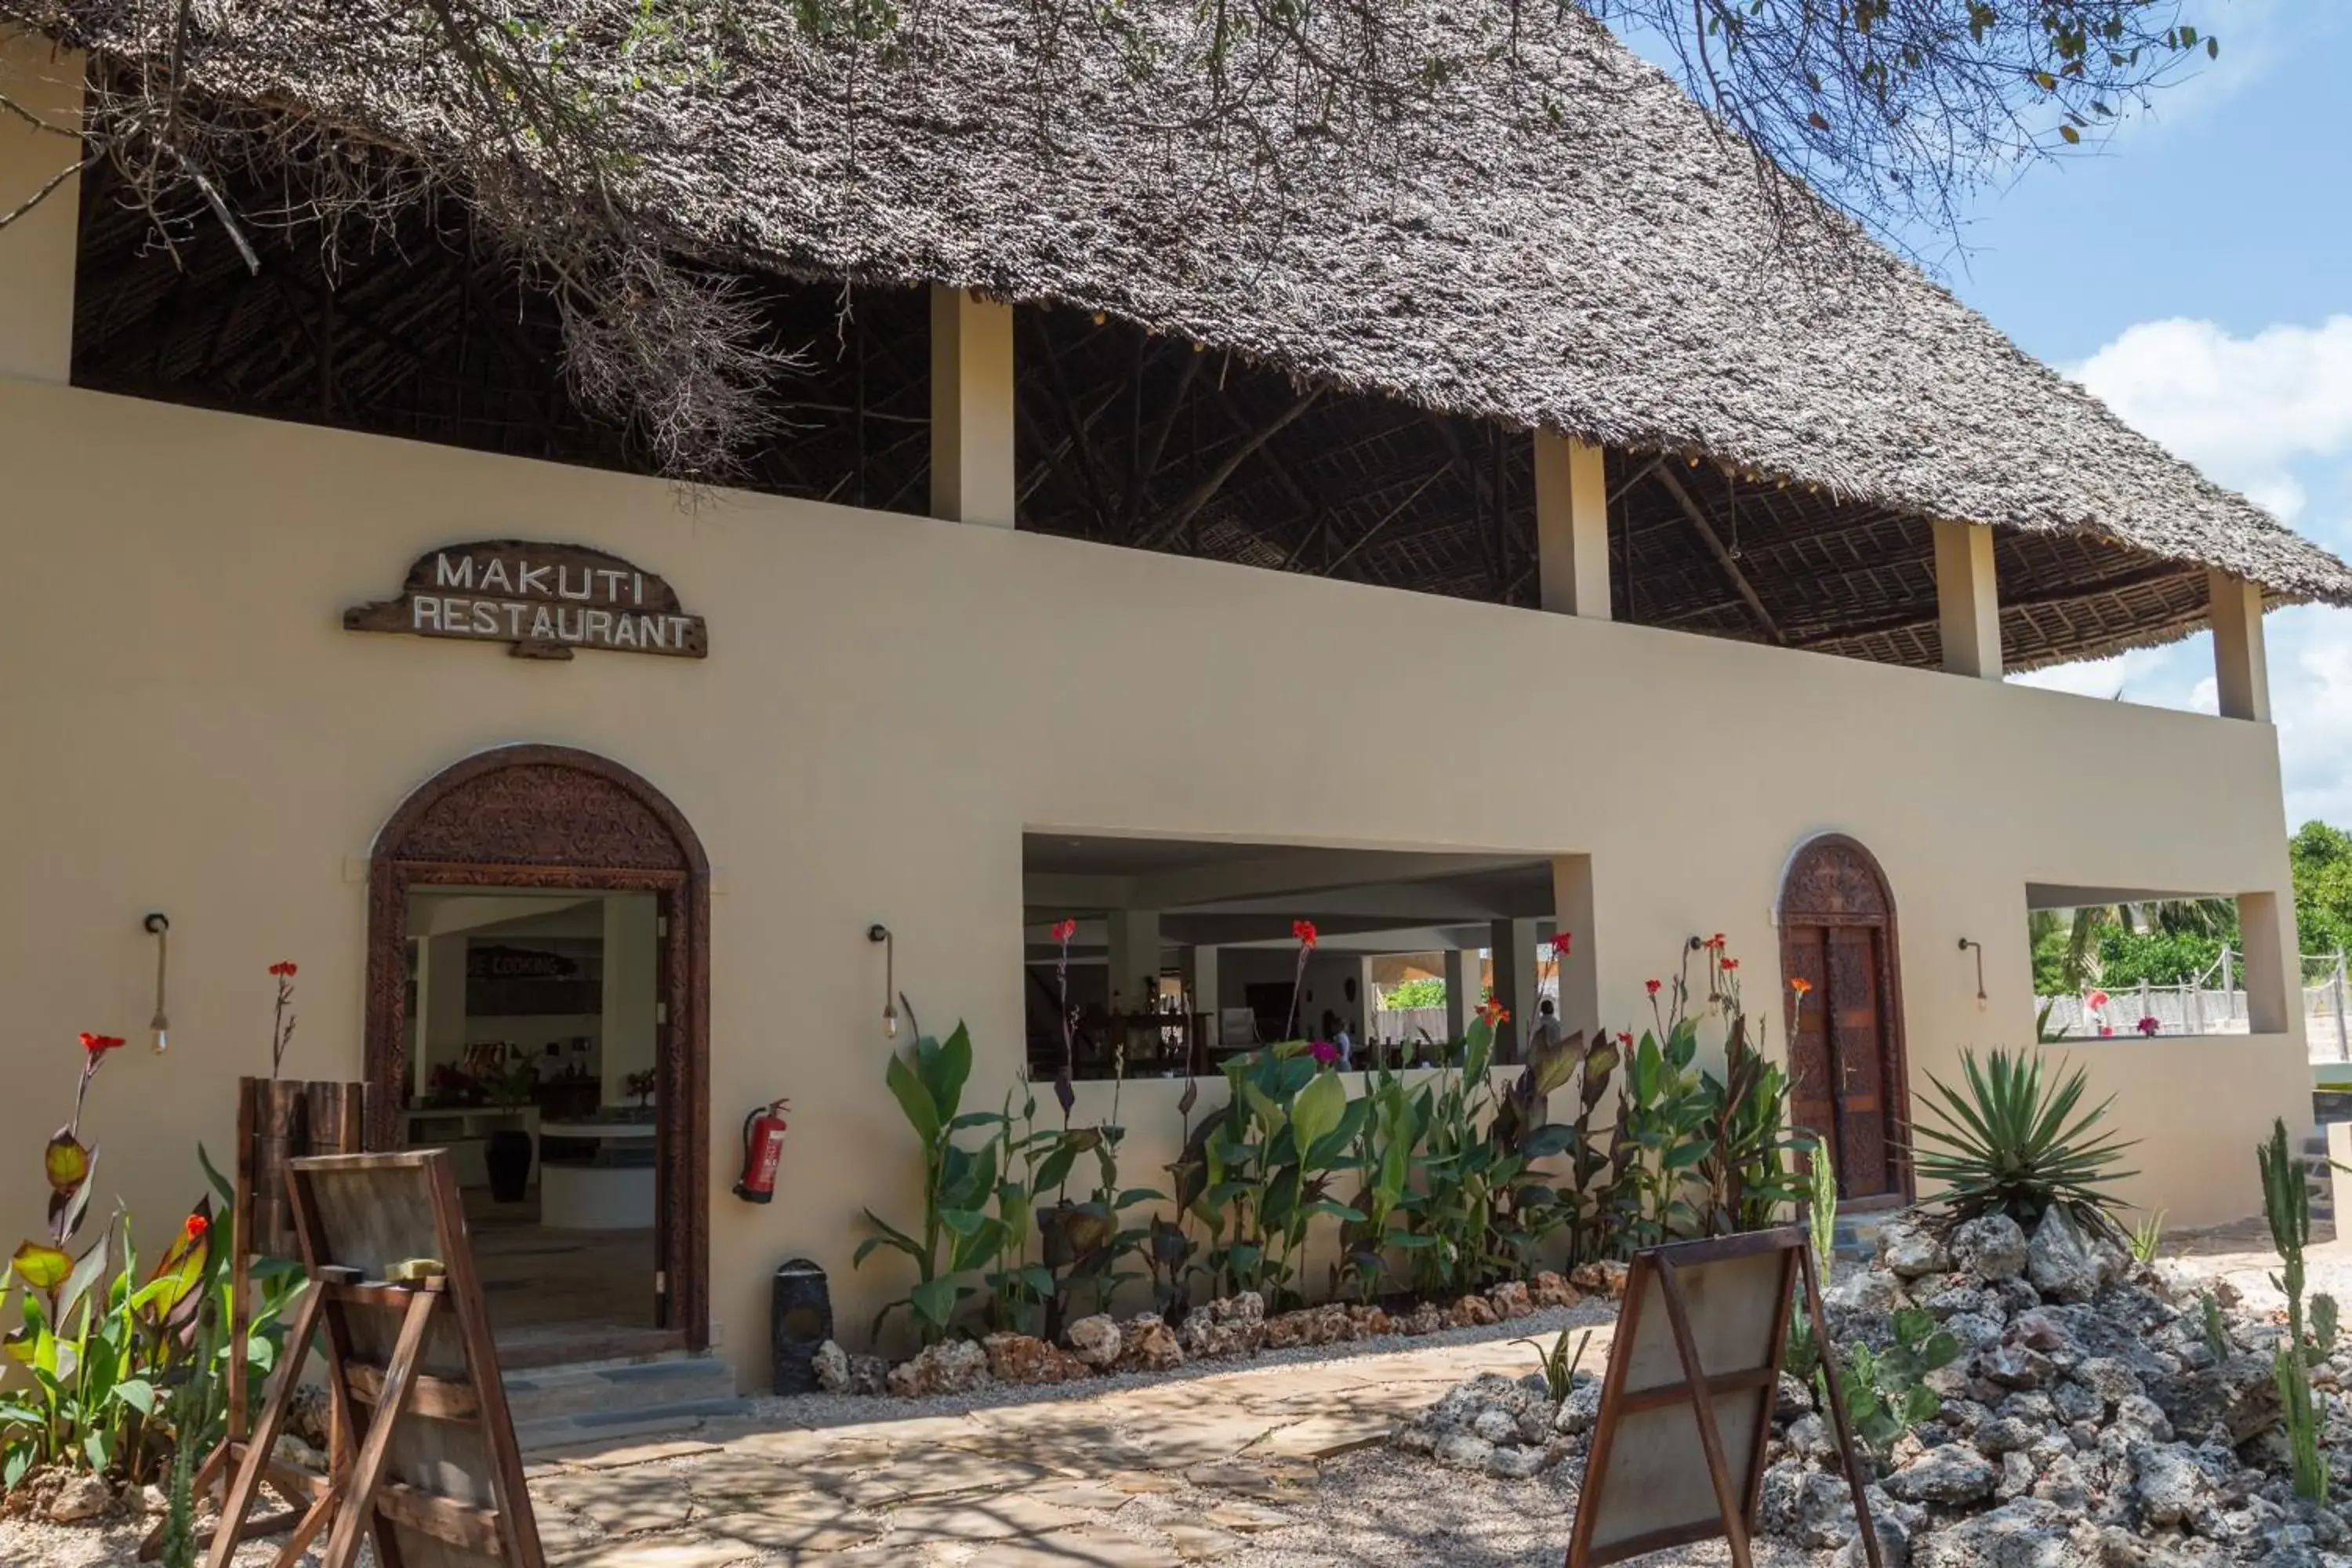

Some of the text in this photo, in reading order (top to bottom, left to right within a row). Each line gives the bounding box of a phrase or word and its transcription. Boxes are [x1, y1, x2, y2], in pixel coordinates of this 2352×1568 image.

[437, 553, 643, 604] MAKUTI
[414, 595, 692, 648] RESTAURANT
[493, 956, 559, 974] COOKING
